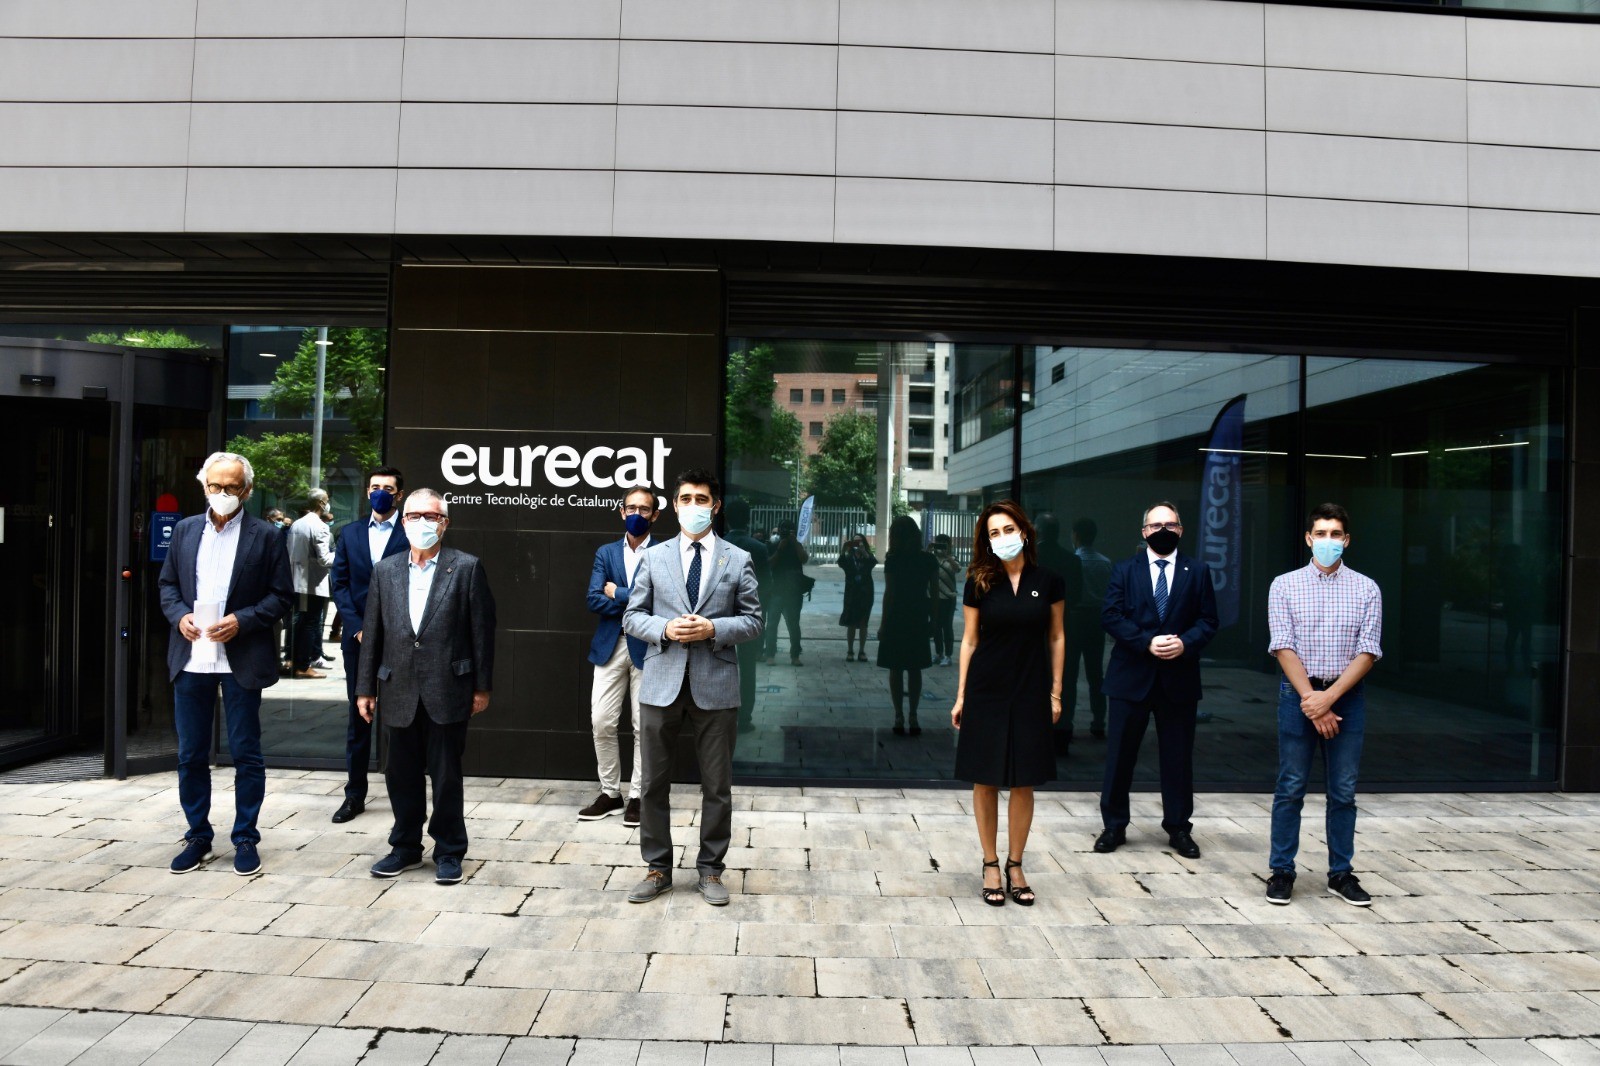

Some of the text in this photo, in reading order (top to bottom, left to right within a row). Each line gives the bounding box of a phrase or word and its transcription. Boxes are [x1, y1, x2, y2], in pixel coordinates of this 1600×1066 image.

[440, 437, 672, 489] eurecat
[443, 492, 625, 512] Centre Tecnològic de Catalunya
[1204, 450, 1232, 592] eurecat
